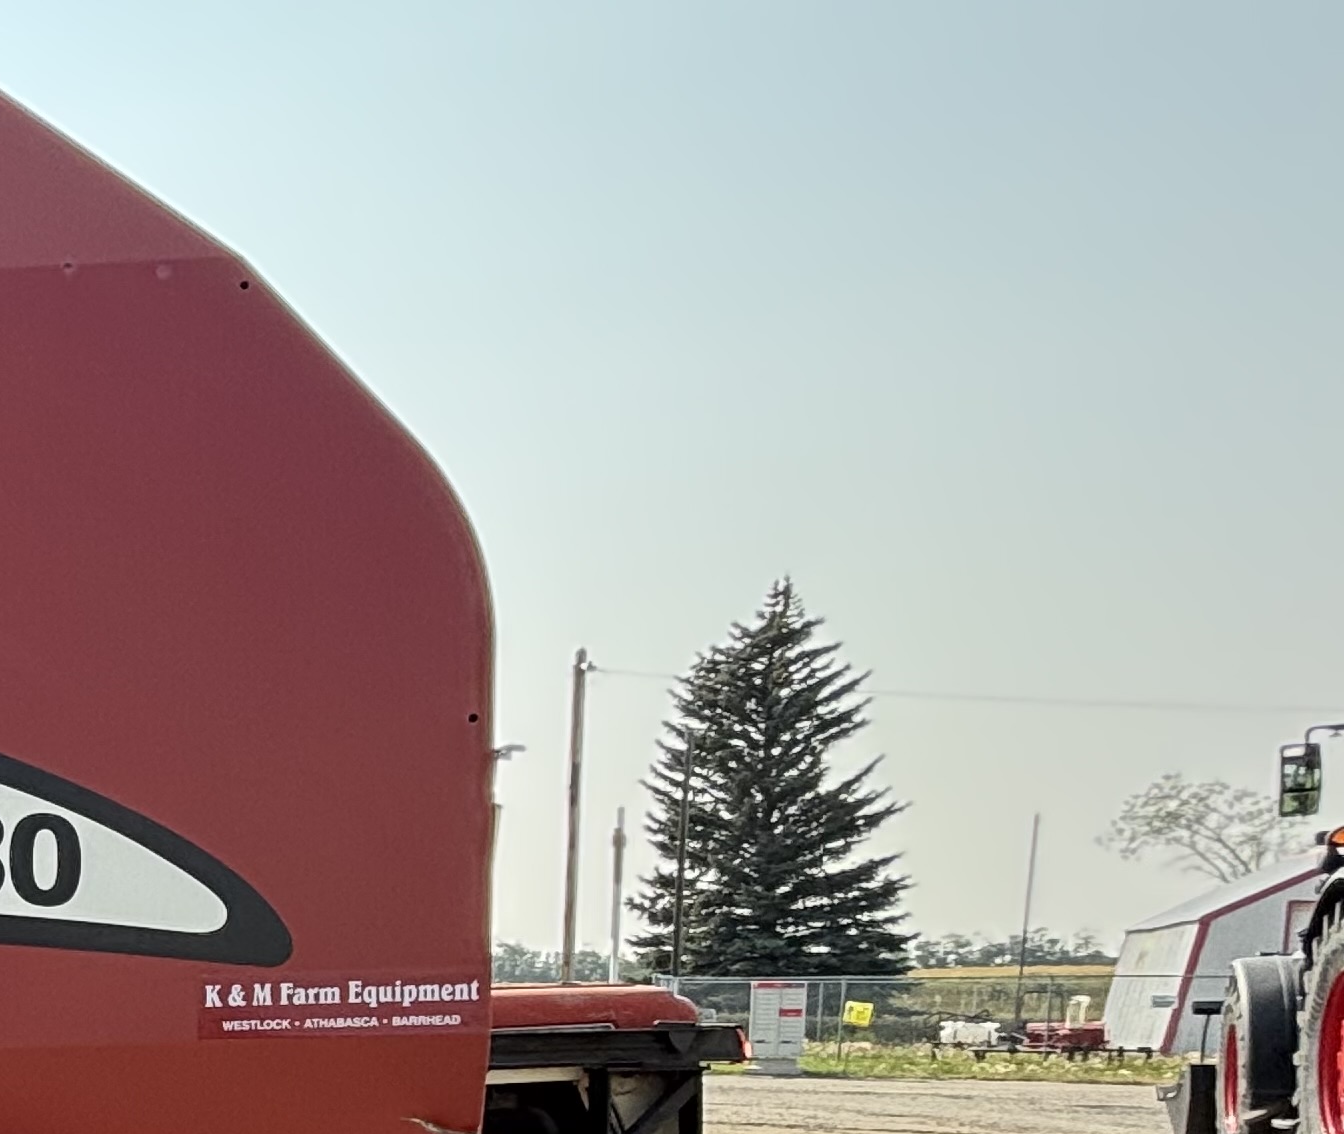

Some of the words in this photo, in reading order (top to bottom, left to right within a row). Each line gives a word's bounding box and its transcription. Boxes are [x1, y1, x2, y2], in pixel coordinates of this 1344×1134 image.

[204, 984, 223, 1008] K
[227, 983, 247, 1007] &
[252, 983, 273, 1007] M
[279, 982, 341, 1006] Farm
[348, 980, 480, 1008] Equipment
[222, 1018, 292, 1032] WESTLOCK
[303, 1016, 379, 1030] ATHABASCA
[391, 1014, 462, 1028] BARRHEAD
